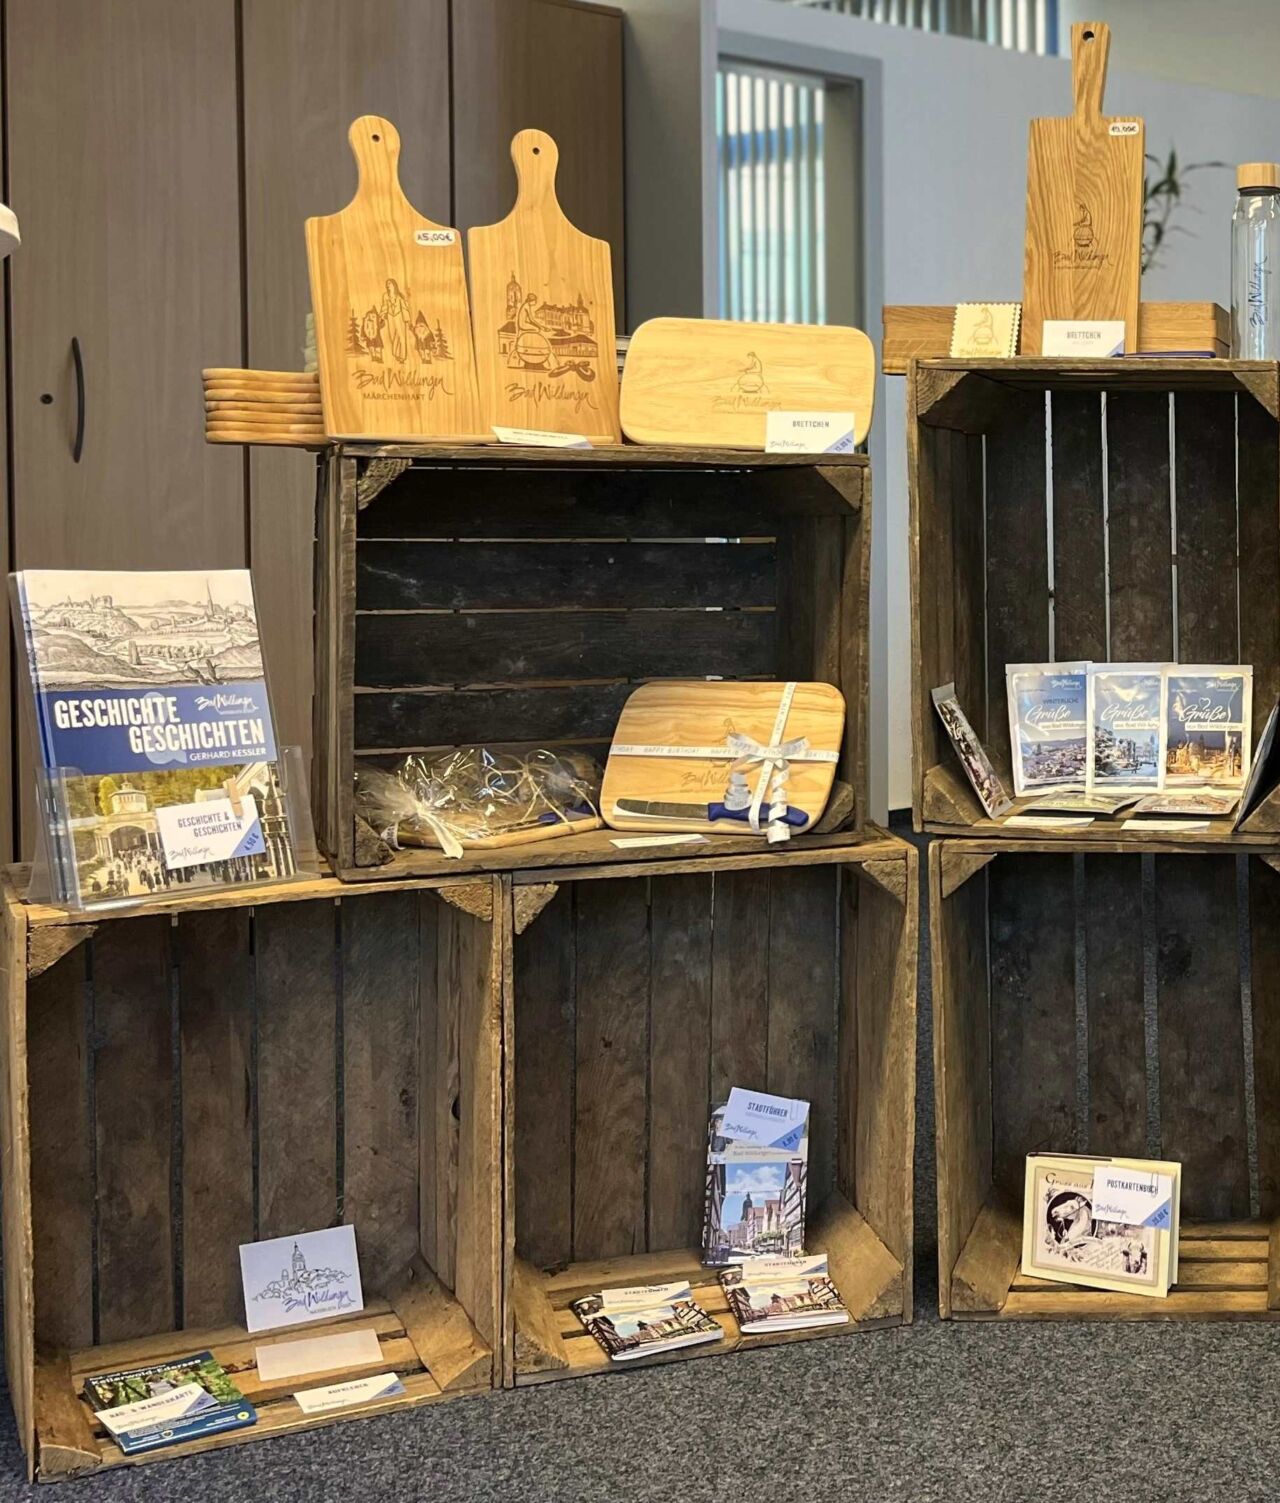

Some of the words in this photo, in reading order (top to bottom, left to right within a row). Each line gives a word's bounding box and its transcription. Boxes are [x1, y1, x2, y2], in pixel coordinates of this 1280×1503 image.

[1066, 331, 1102, 340] BRETTCHEN
[351, 369, 387, 391] Bad
[387, 369, 455, 401] Wildungen
[504, 382, 538, 409] Bad
[537, 381, 599, 414] Wildungen
[792, 420, 830, 428] BRETTCHEN
[53, 696, 181, 729] GESCHICHTE
[1178, 703, 1227, 724] Grüße
[128, 718, 266, 754] GESCHICHTEN
[189, 750, 231, 761] GERHARD
[231, 747, 267, 758] KESSLER
[177, 812, 221, 828] GESCHICHTE
[224, 811, 230, 821] &
[193, 822, 242, 838] GESCHICHTEN
[747, 1101, 789, 1118] STADTFÜHRER
[1106, 1178, 1159, 1195] POSTKARTENBUCH
[281, 1294, 310, 1314] Bad
[307, 1289, 357, 1310] Wildungen
[91, 1358, 202, 1386] Kellerwald-Edersee
